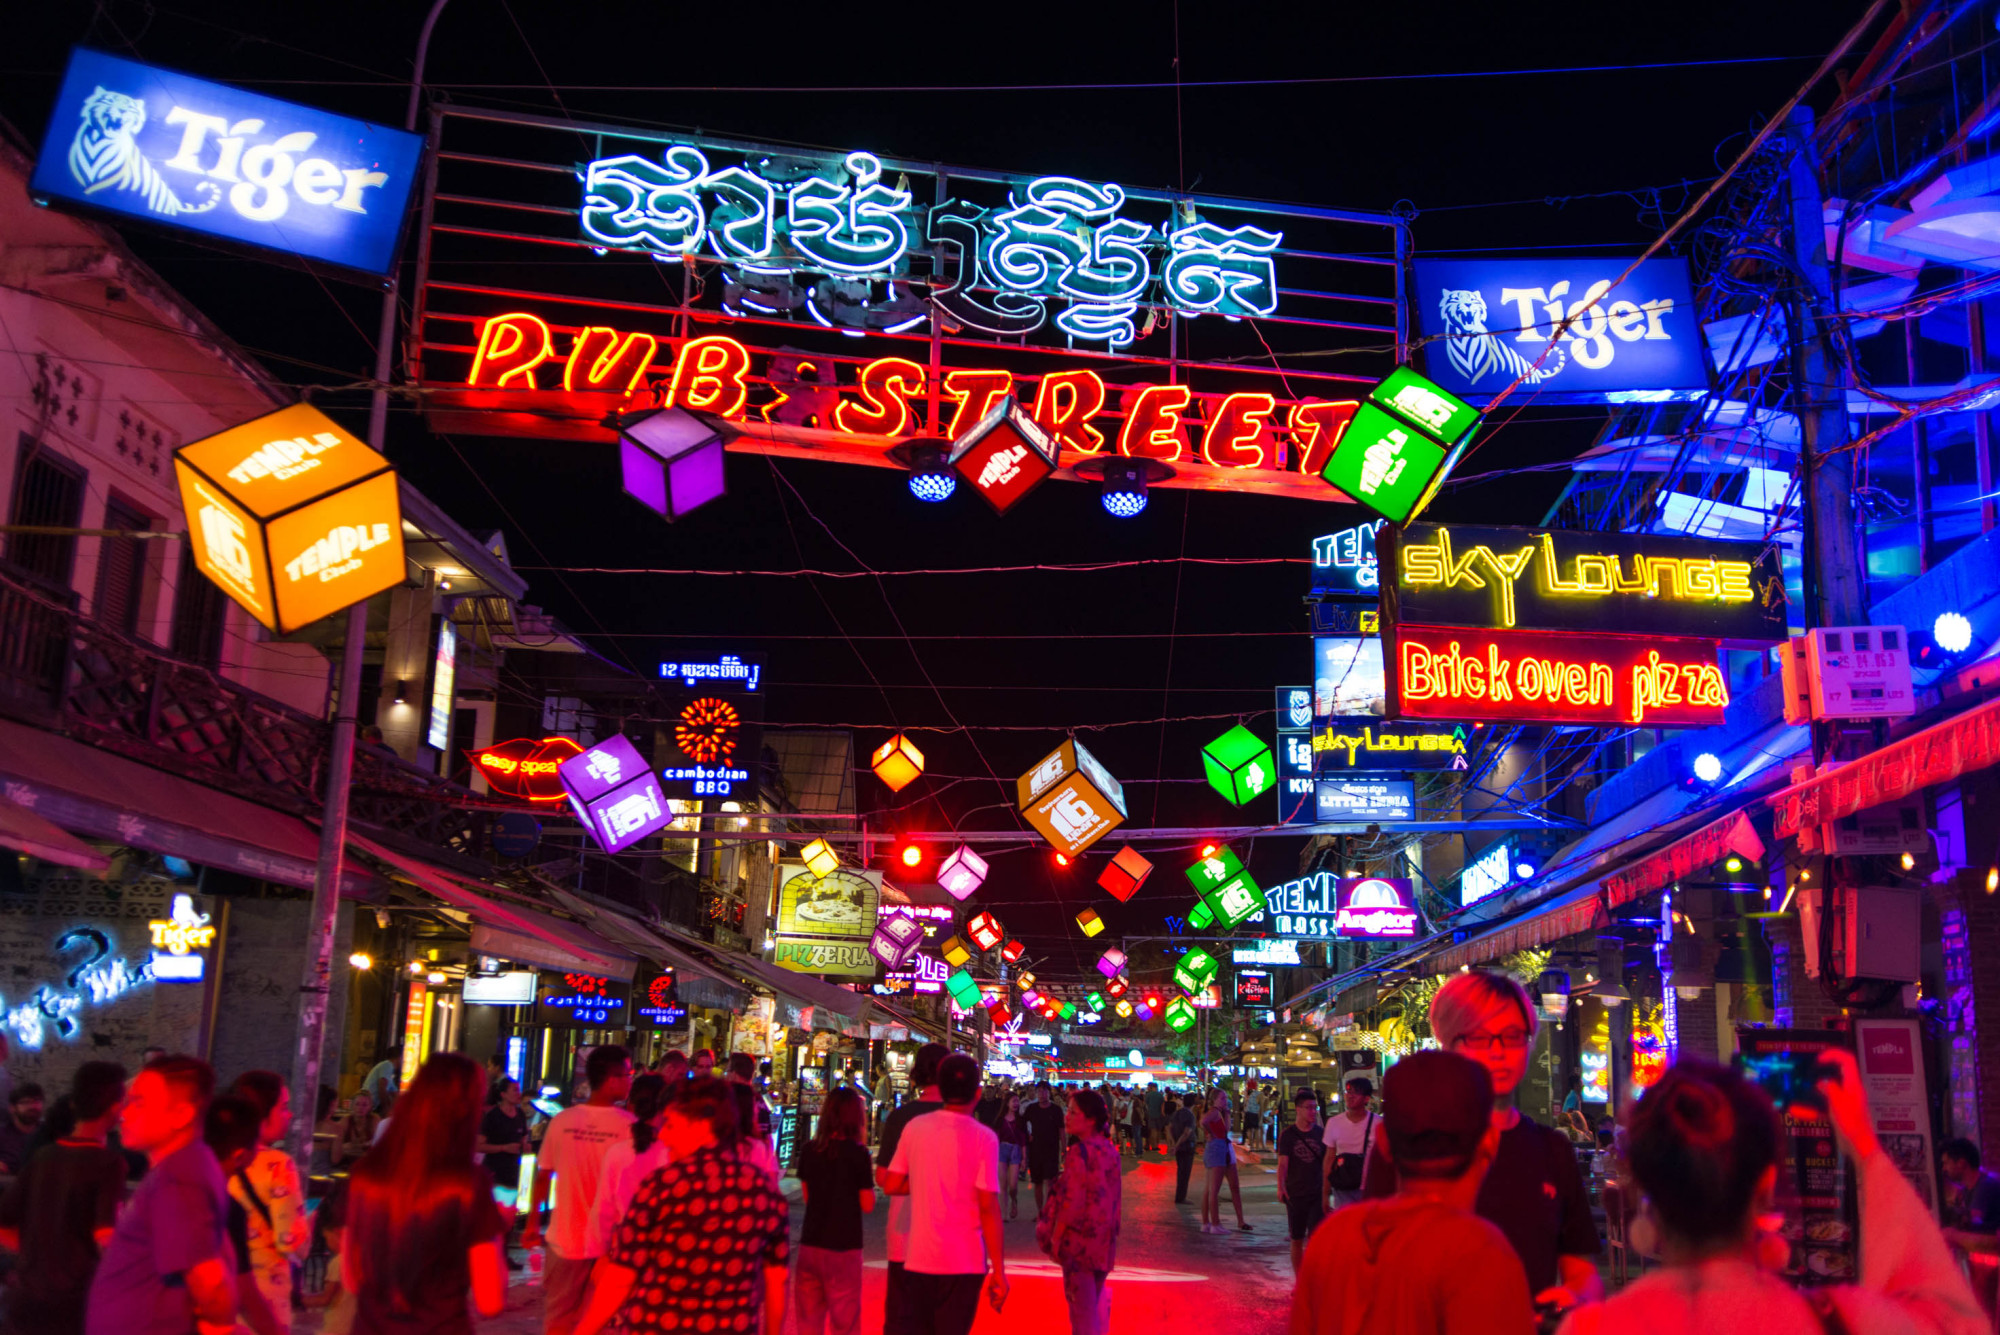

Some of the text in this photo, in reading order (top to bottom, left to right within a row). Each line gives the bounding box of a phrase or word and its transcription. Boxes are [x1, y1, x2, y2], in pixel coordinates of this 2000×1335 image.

[165, 105, 390, 221] Tiger
[1501, 279, 1675, 370] Tiger
[468, 312, 752, 419] PUB
[833, 356, 1362, 477] STREET
[227, 431, 342, 484] TEMPLE
[978, 444, 1028, 488] TEMPLE
[284, 522, 391, 582] TEMPLE
[1403, 639, 1731, 724] Brick oven pizza
[480, 753, 518, 774] easy
[664, 765, 748, 780] cambodian
[1030, 758, 1064, 796] 16
[694, 780, 731, 795] BBQ
[1319, 795, 1411, 808] LITTLE INDIA
[1049, 787, 1095, 837] 16
[1065, 814, 1102, 843] years
[1264, 871, 1340, 914] TEMP
[149, 920, 217, 955] Tiger
[1335, 909, 1418, 934] Angkor
[777, 942, 874, 969] PIZZERIA
